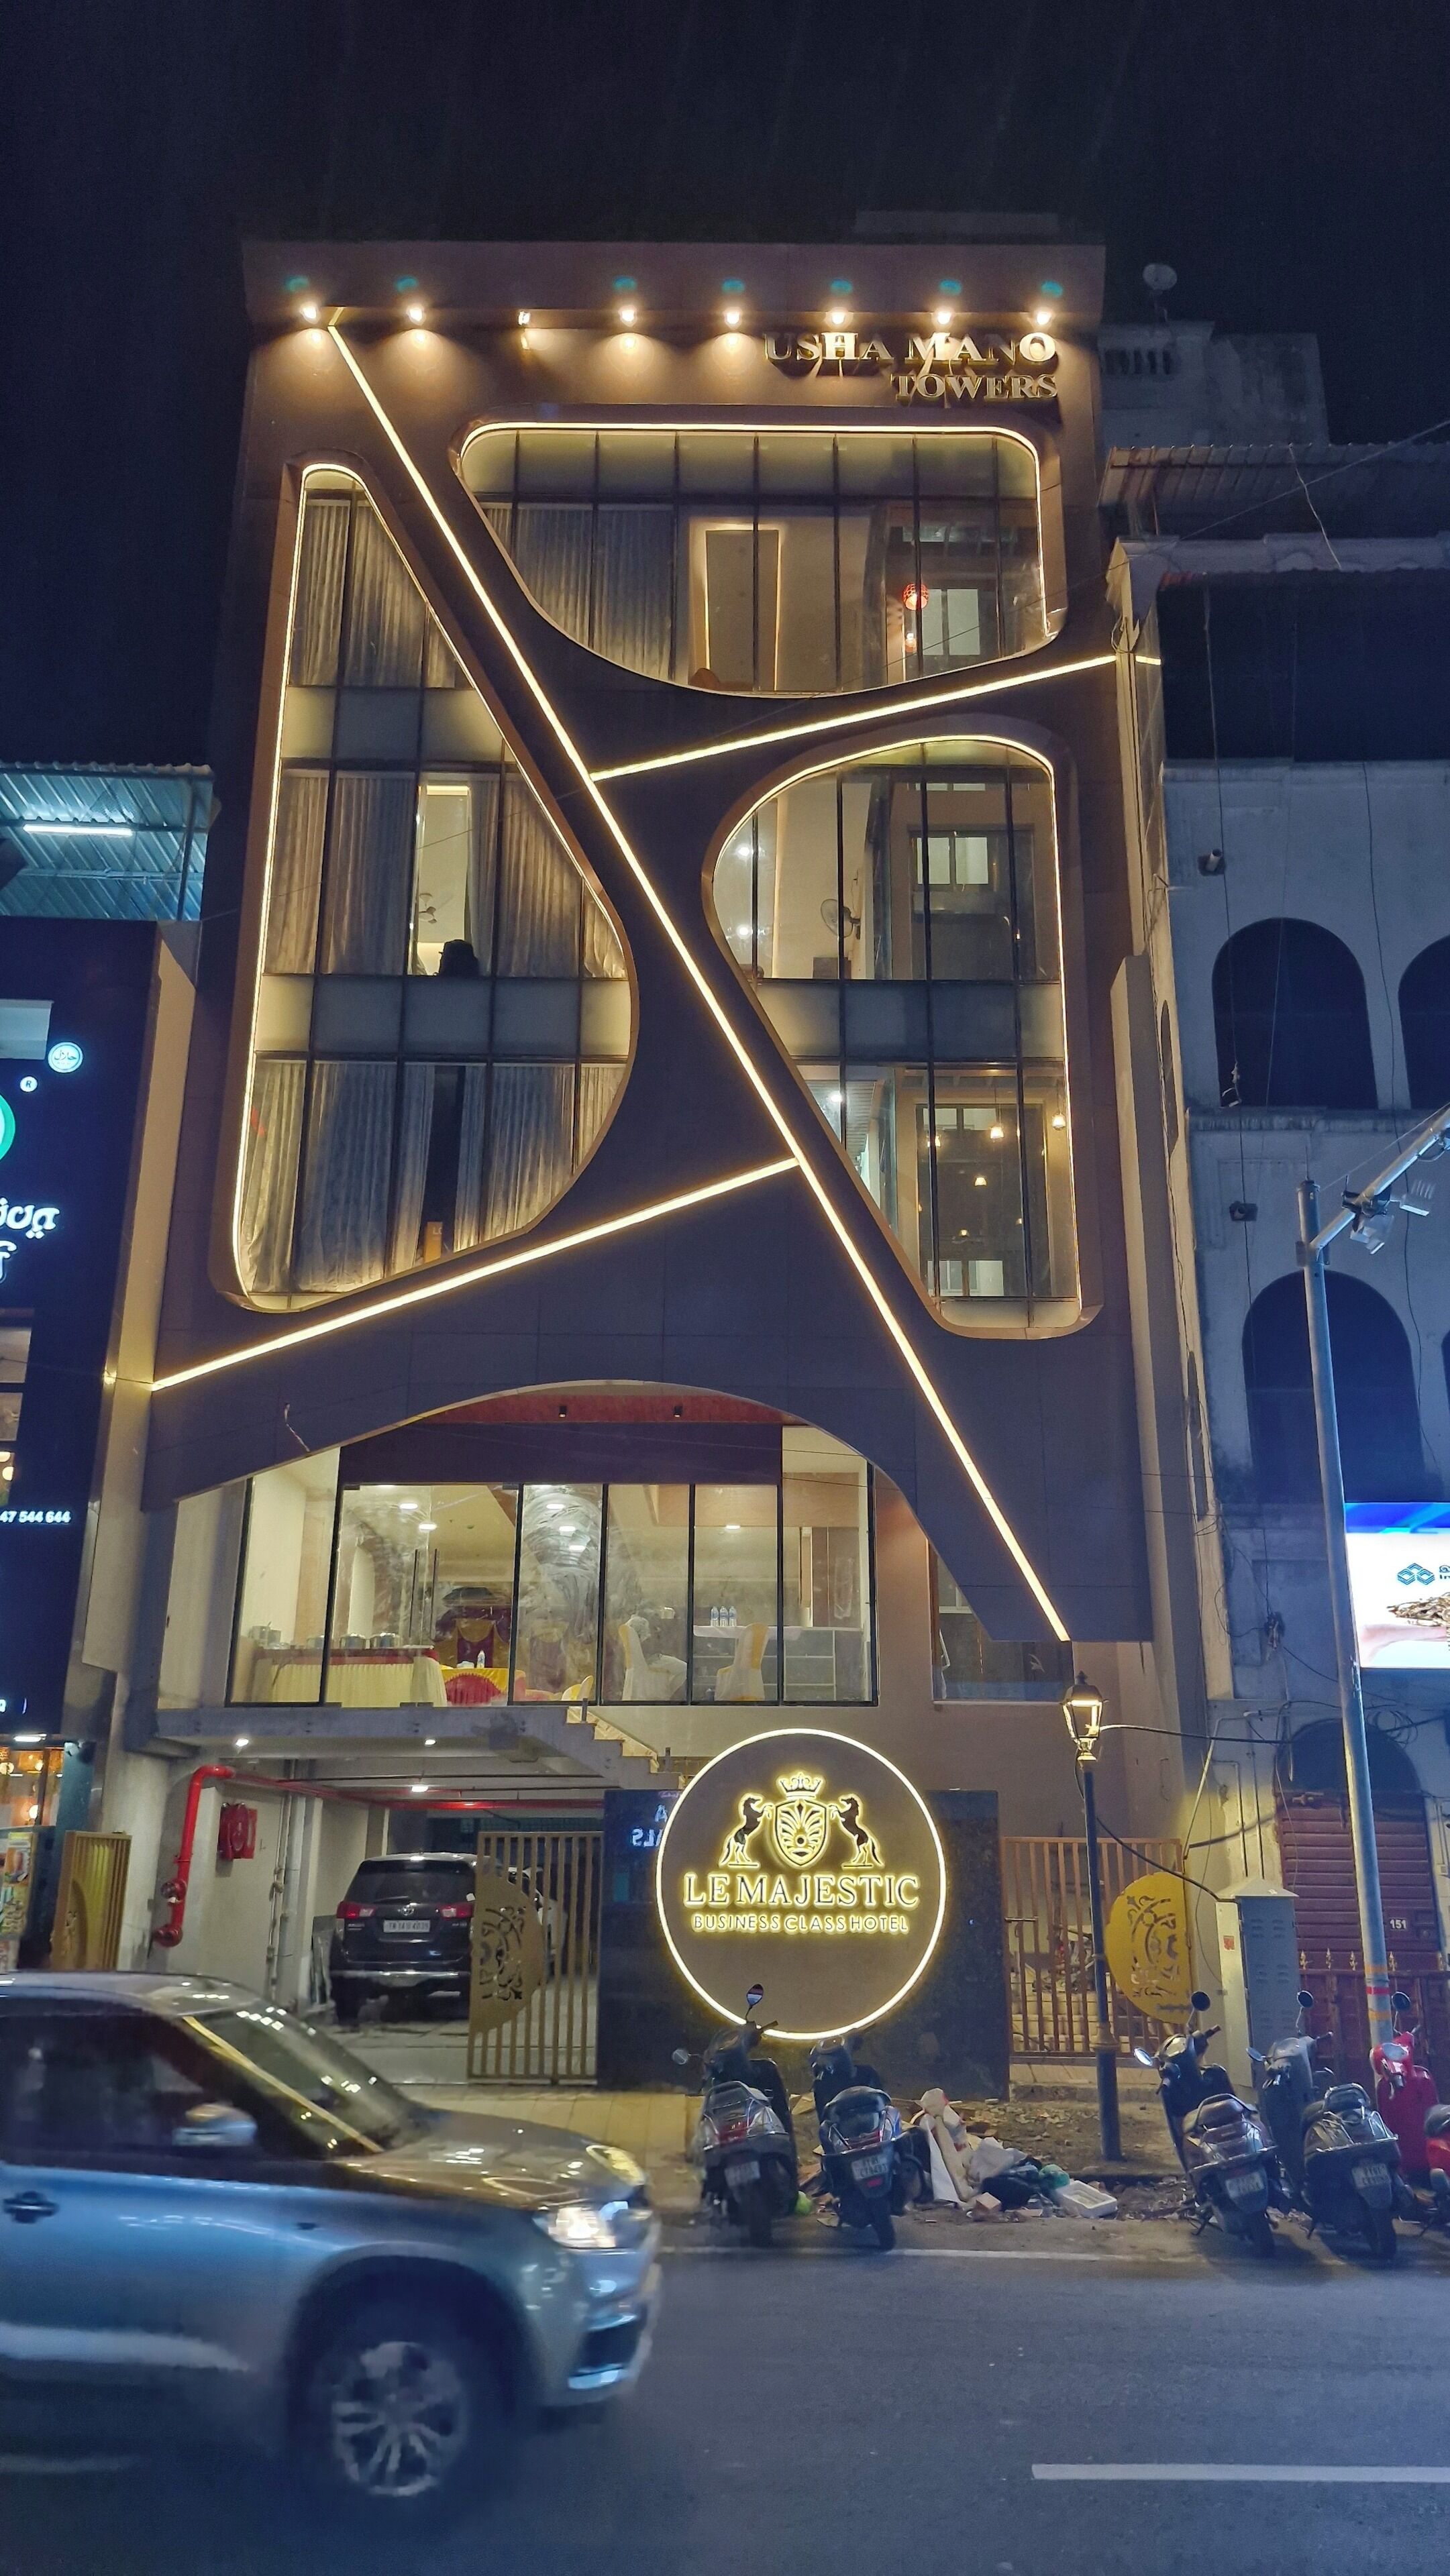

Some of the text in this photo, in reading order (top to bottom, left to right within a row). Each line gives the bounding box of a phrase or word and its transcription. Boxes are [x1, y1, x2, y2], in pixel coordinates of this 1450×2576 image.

[764, 331, 1057, 363] USHA MANO
[890, 373, 1057, 402] TOWERS
[25, 1080, 32, 1088] R
[19, 1510, 44, 1523] 544
[45, 1510, 71, 1523] 644
[684, 1874, 920, 1907] LE MAJESTIC
[693, 1914, 909, 1932] BUSINESS CLASS HOTEL
[1390, 1919, 1406, 1929] 151
